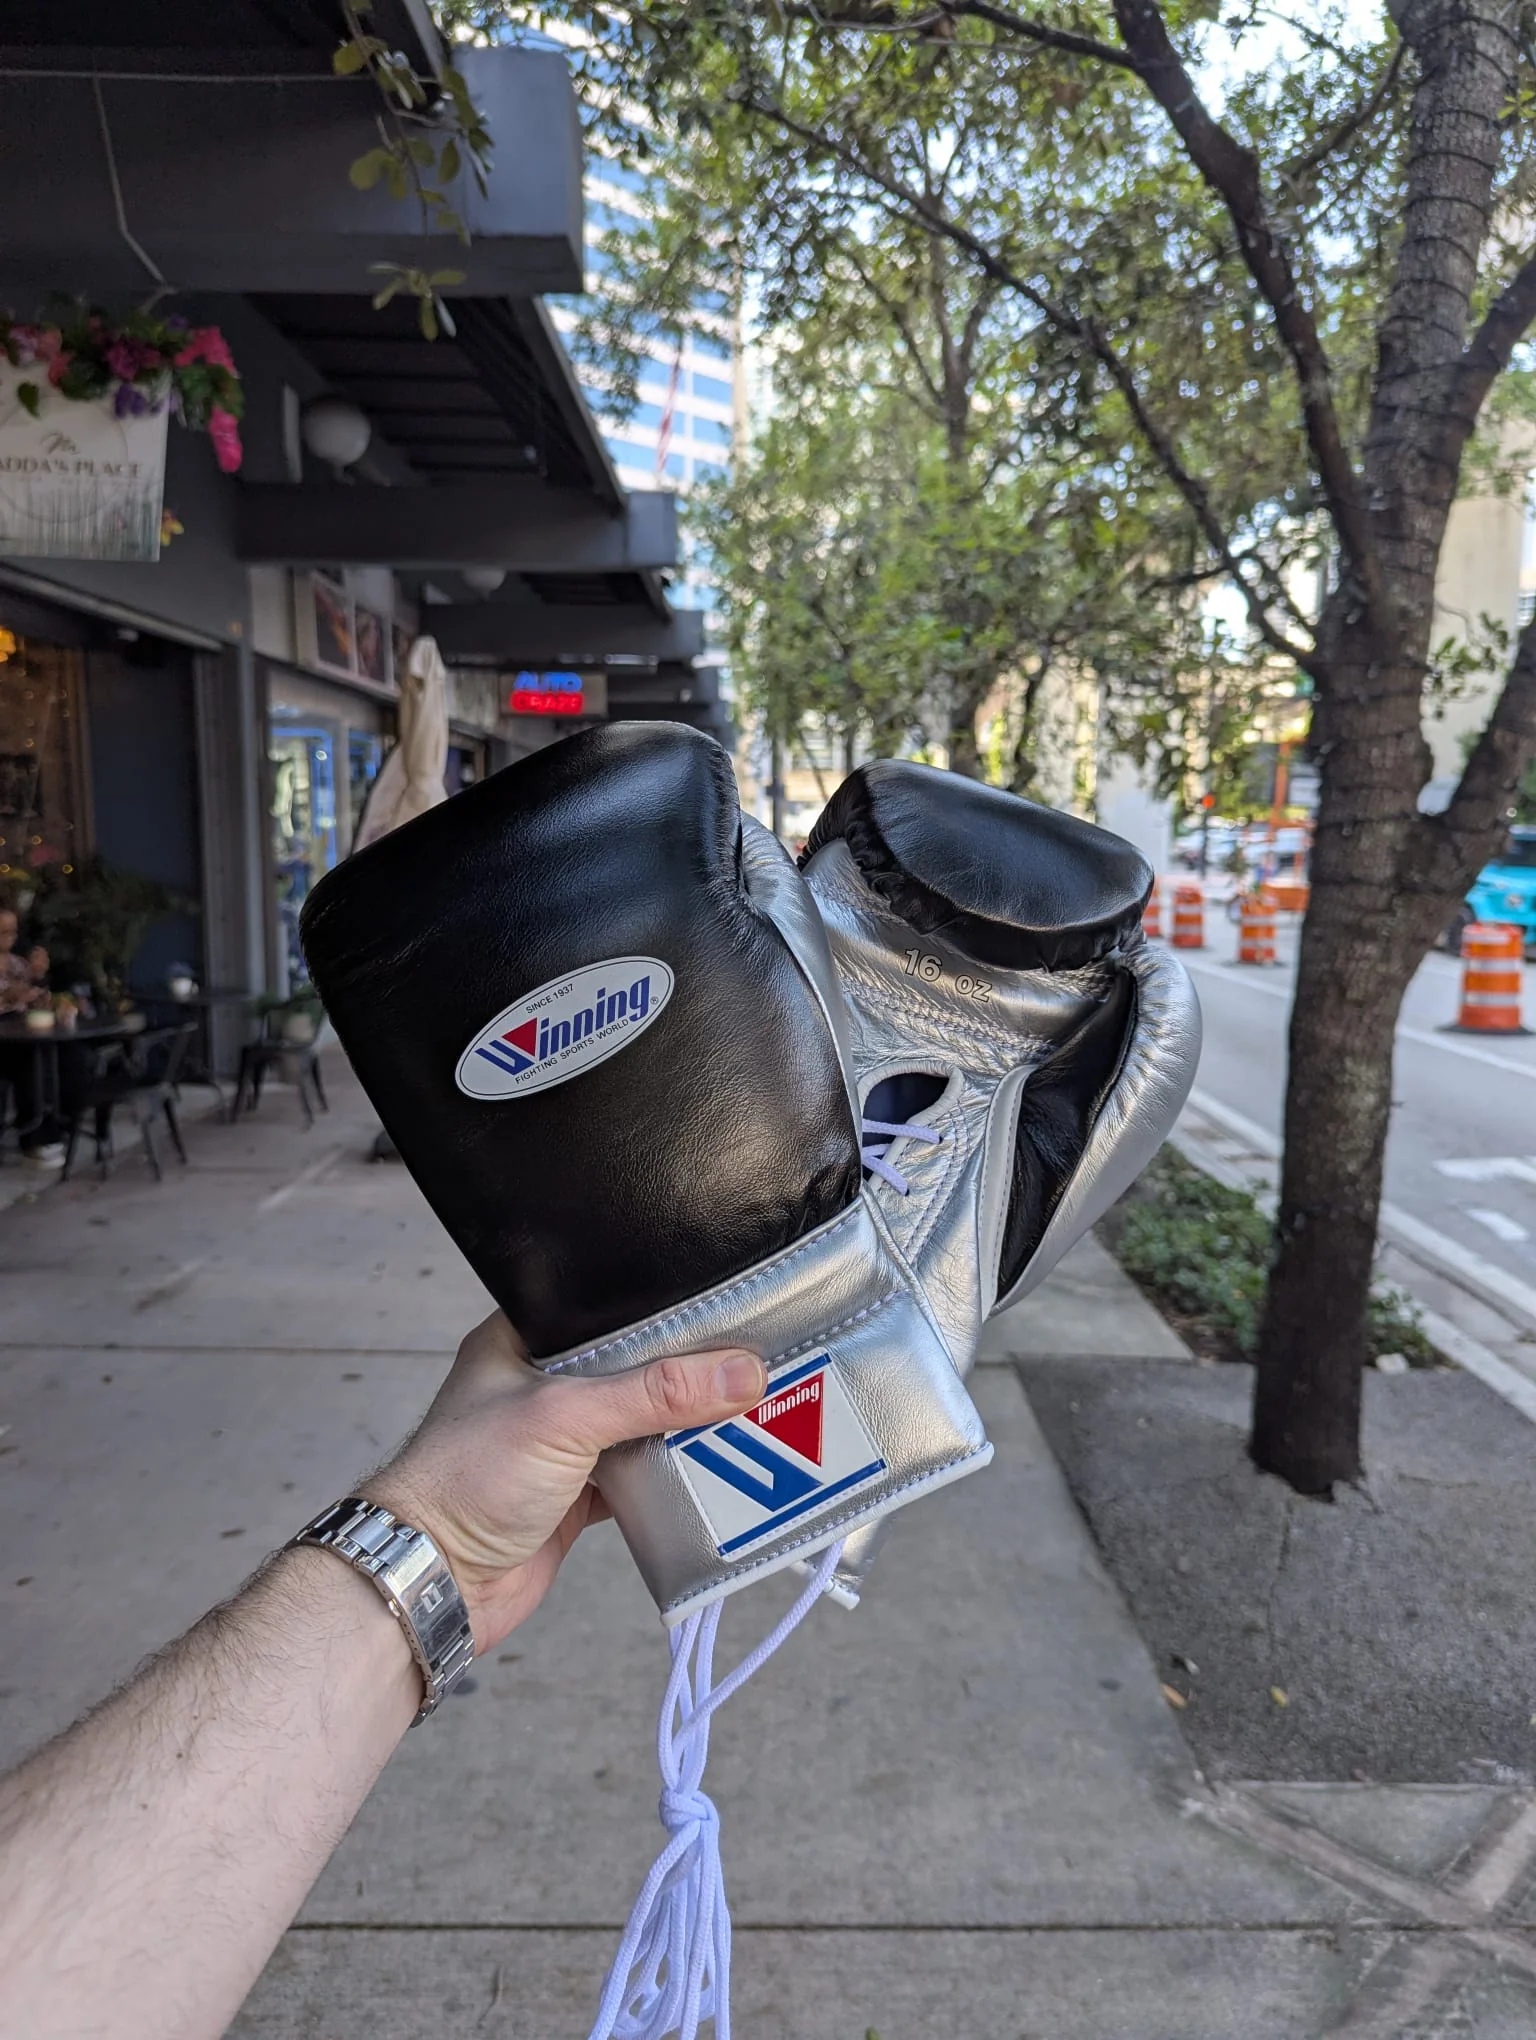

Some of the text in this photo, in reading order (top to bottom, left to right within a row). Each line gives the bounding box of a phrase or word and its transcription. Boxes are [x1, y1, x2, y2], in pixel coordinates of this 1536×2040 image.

[905, 948, 942, 982] 16
[526, 983, 574, 1014] SINCE 1937
[474, 975, 650, 1076] Winning
[515, 1018, 629, 1084] FIGHTING SPORTS WORLD
[758, 1381, 820, 1425] Winning
